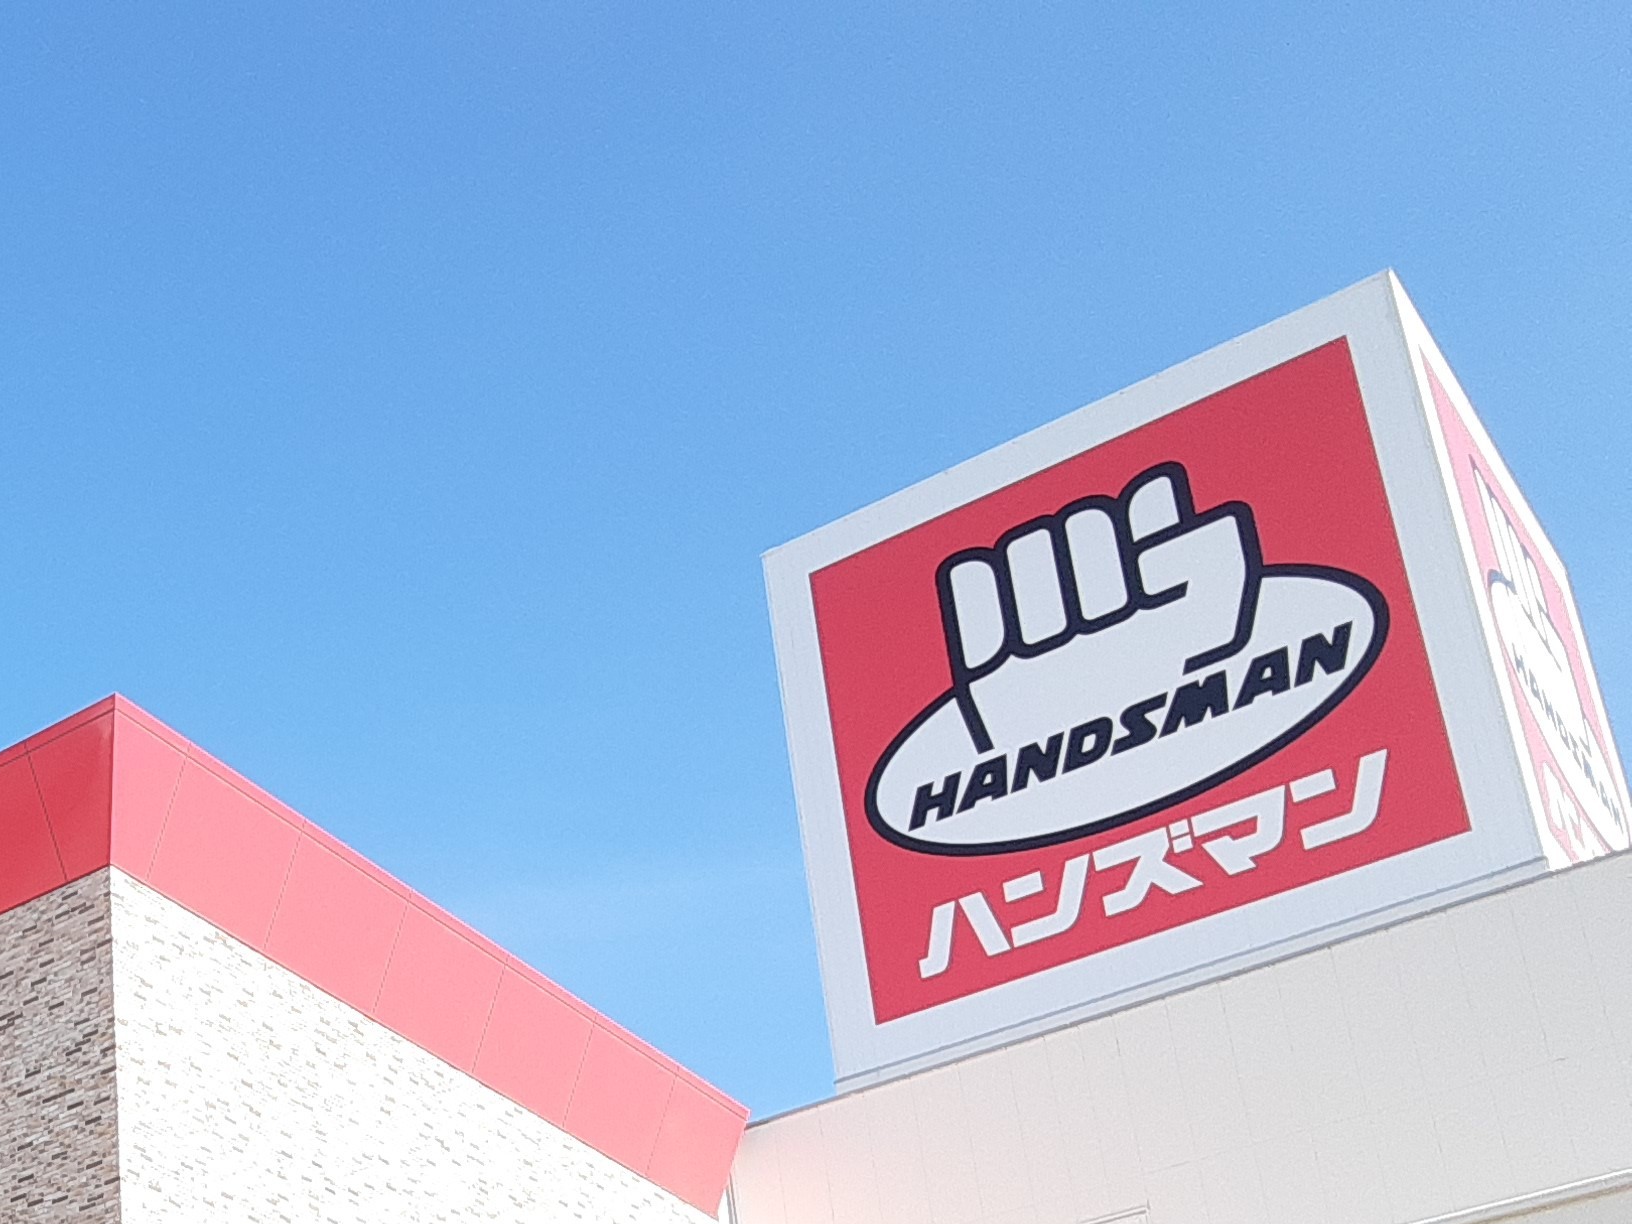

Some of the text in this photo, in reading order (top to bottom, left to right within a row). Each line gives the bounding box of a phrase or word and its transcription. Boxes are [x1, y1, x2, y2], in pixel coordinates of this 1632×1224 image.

[907, 620, 1353, 831] HANDSMAN
[918, 748, 1389, 980] ハンズマン
